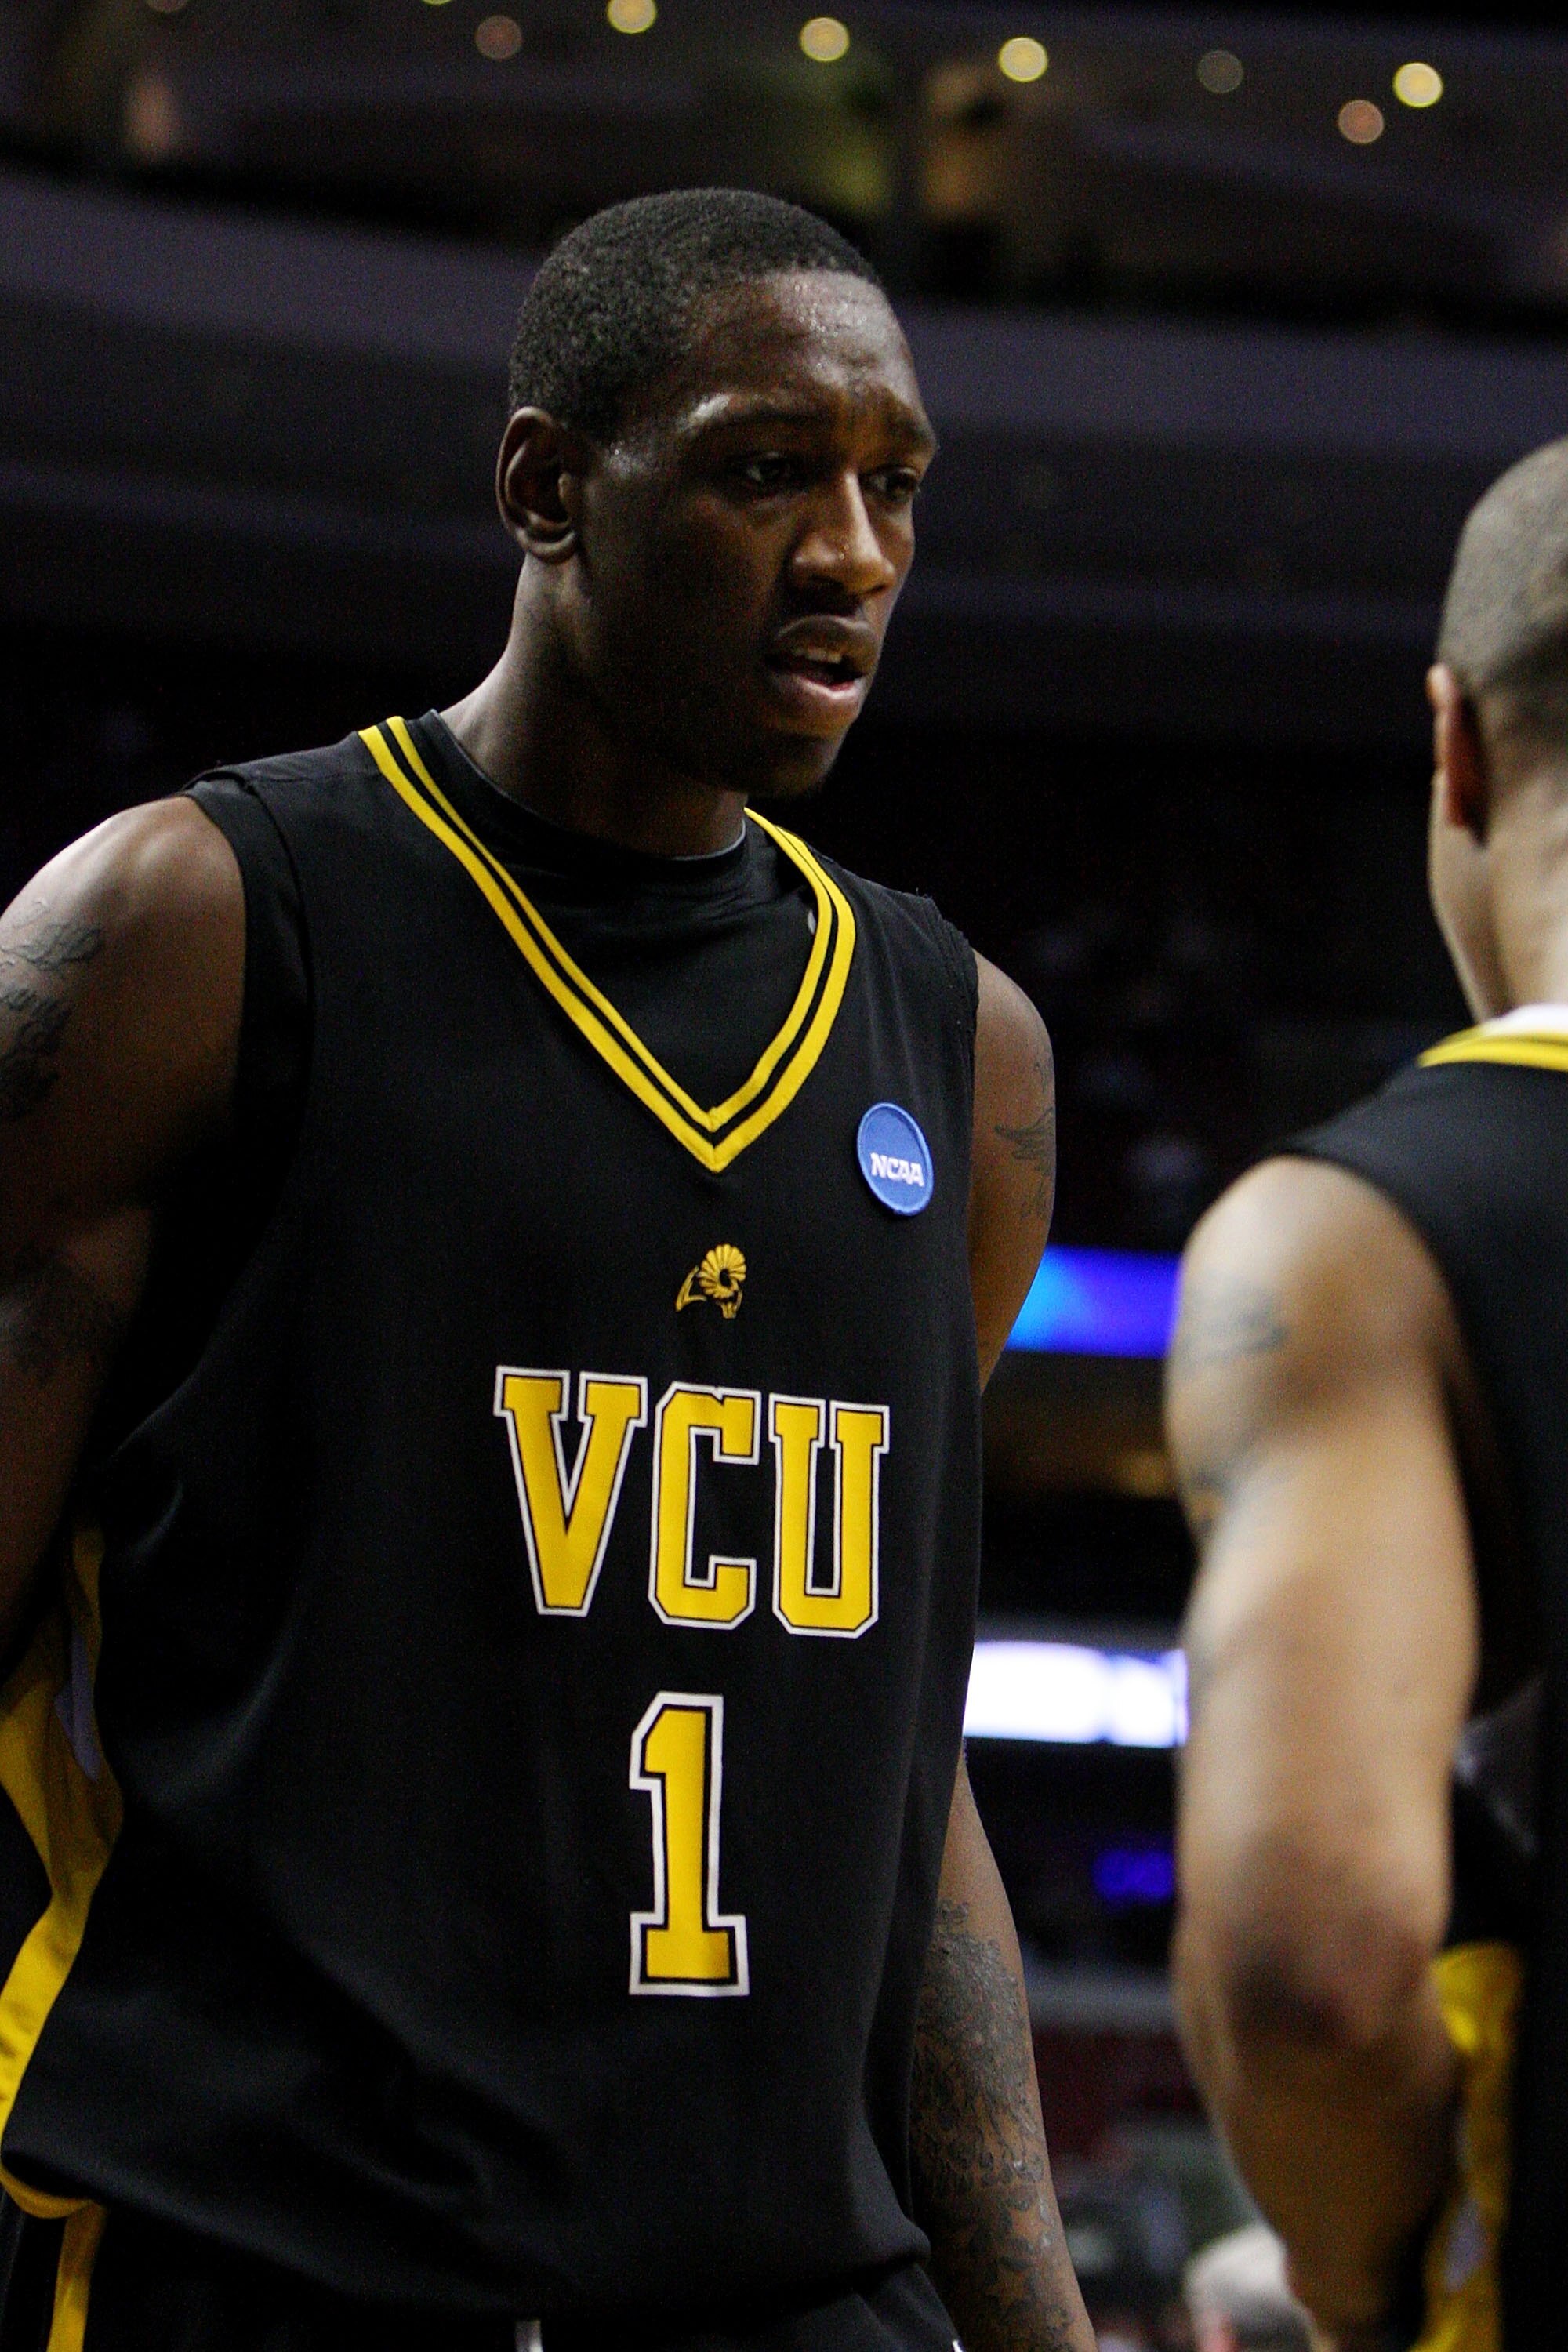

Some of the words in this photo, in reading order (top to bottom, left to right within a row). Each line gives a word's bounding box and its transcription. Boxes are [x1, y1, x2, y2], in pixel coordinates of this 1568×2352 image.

[870, 1152, 924, 1187] NCAA
[494, 1366, 890, 1639] VCU
[629, 1691, 750, 1997] 1
